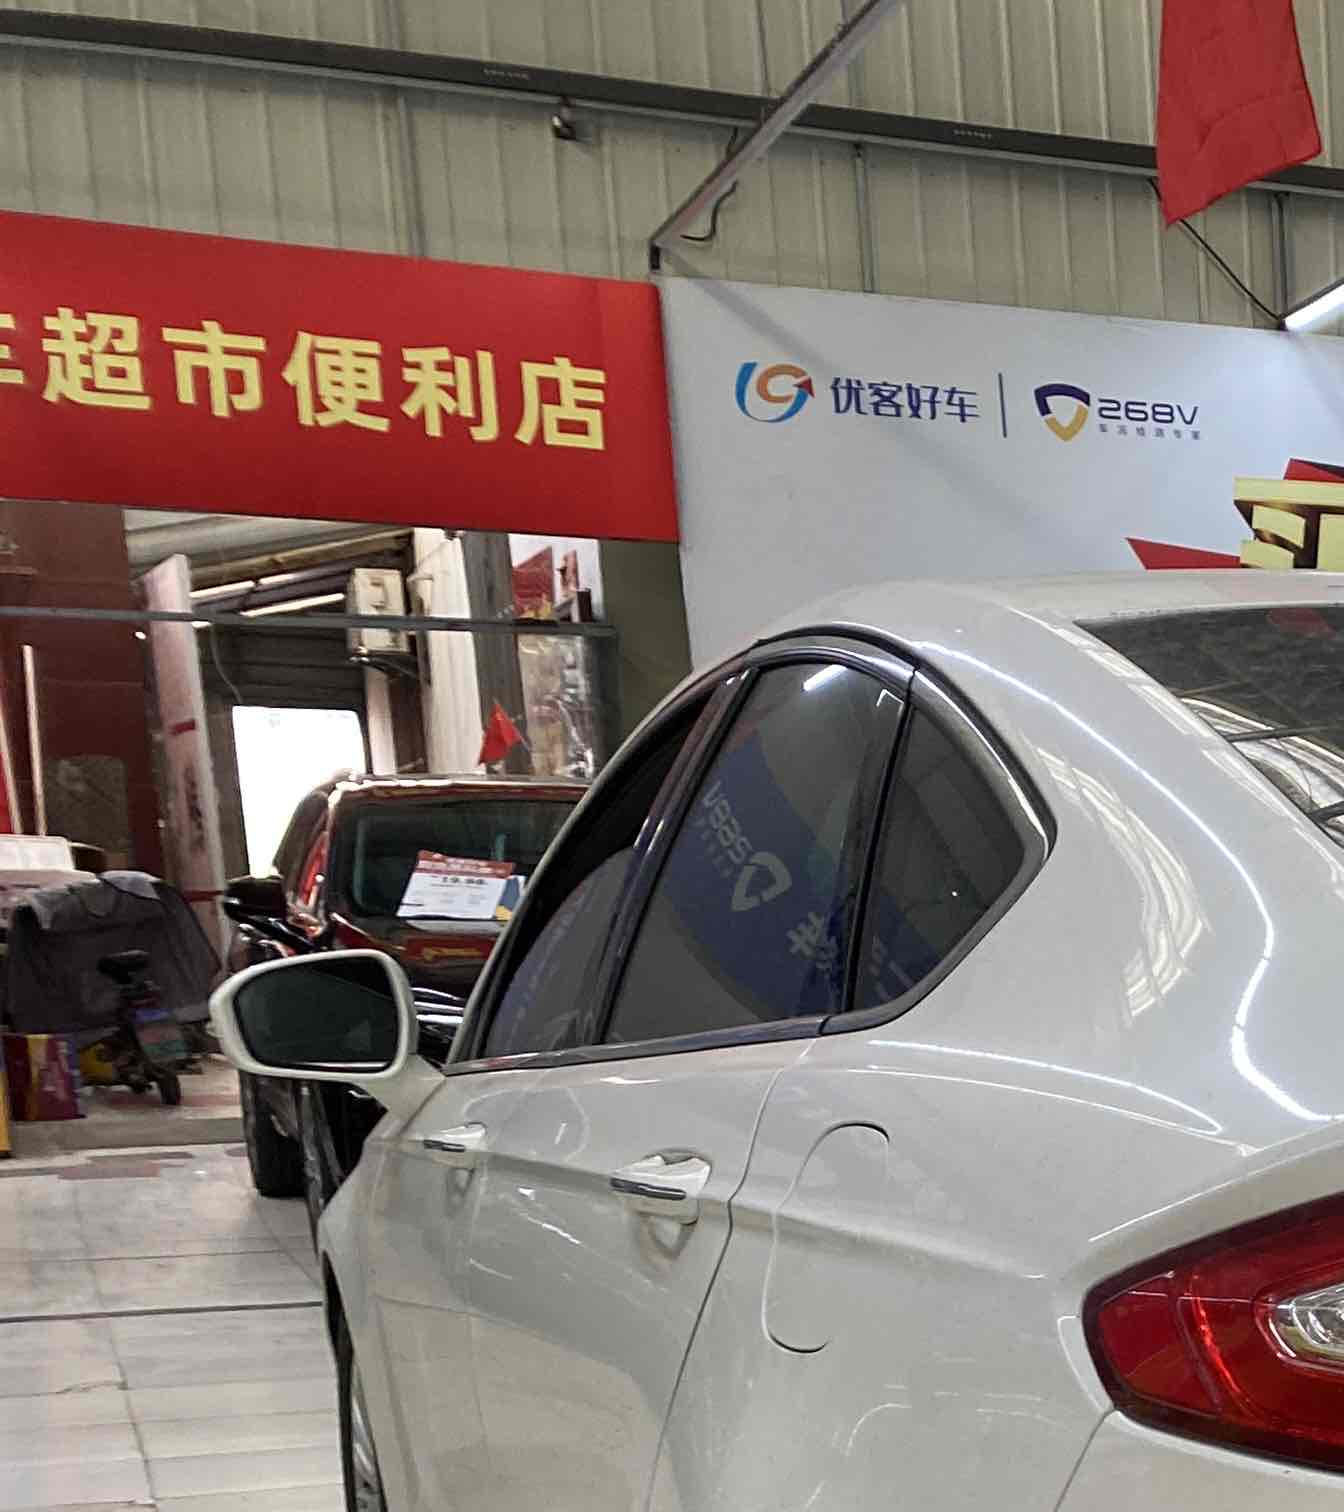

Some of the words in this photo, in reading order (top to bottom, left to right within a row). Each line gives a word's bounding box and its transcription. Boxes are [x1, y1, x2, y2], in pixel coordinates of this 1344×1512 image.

[0, 306, 607, 451] 超市便利店
[830, 376, 980, 423] 优客好车
[1097, 397, 1199, 425] 268V
